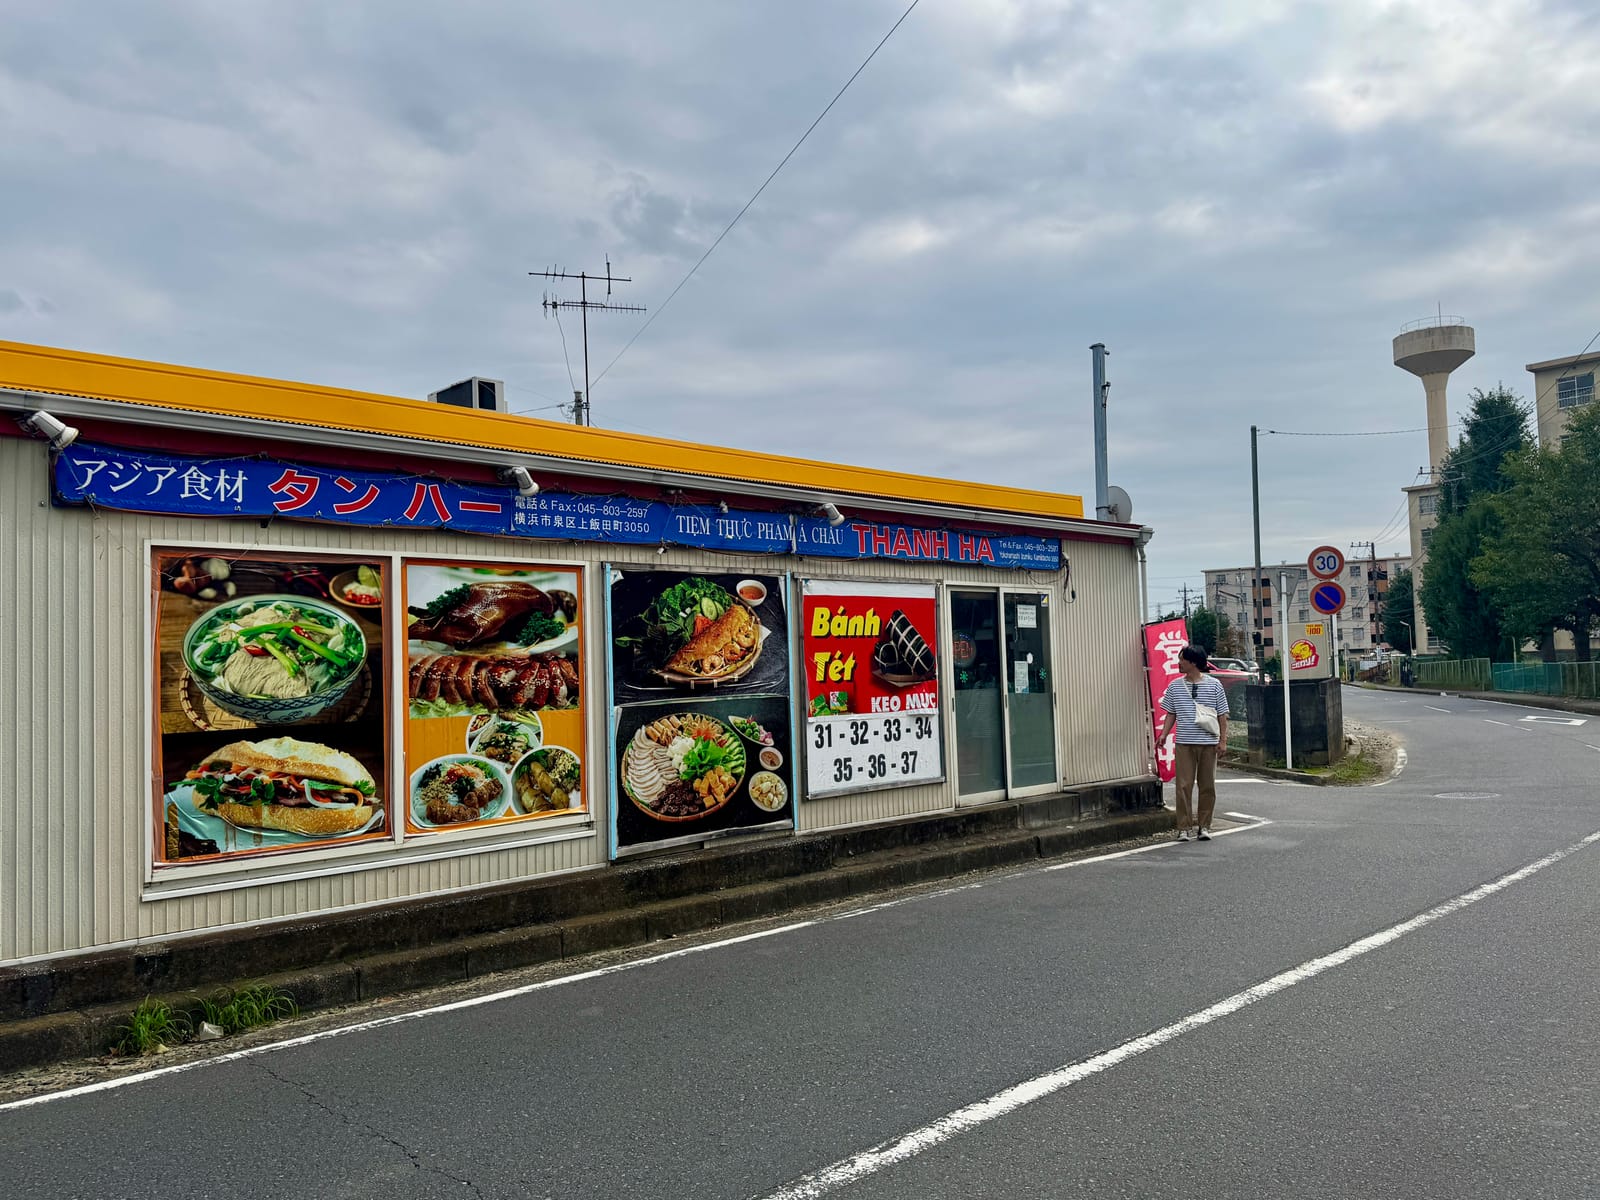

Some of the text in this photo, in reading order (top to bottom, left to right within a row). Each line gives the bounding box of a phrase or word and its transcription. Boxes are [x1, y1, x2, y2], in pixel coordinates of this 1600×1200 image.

[73, 457, 249, 502] アジア食材
[514, 496, 538, 510] 電話
[514, 512, 650, 533] 横浜市泉区上飯田町3050
[852, 524, 995, 562] THANH HA
[1316, 555, 1336, 570] 30
[811, 605, 881, 637] Bánh
[814, 723, 832, 749] 31
[850, 721, 869, 745] 32
[883, 718, 901, 742] 33
[915, 716, 932, 740] 34
[833, 757, 853, 783] 35
[868, 754, 886, 779] 36
[901, 751, 918, 774] 37
